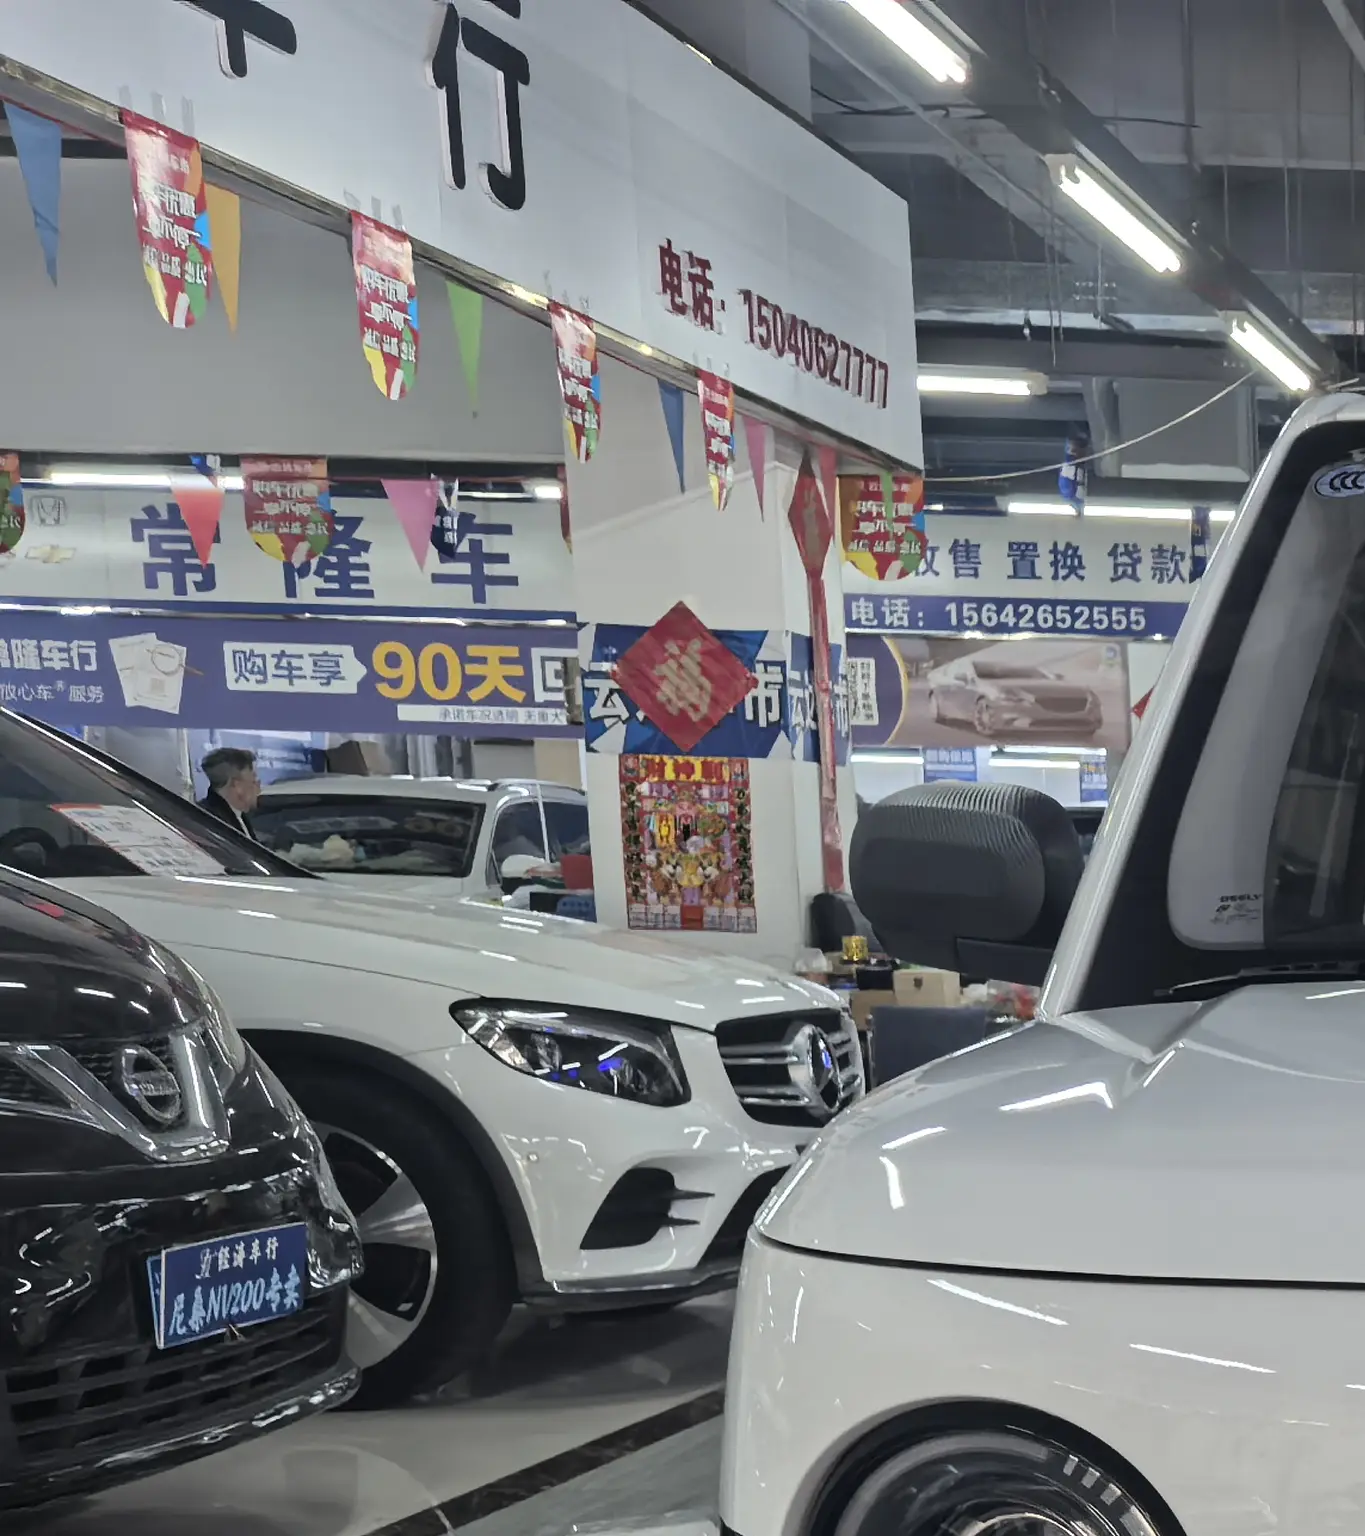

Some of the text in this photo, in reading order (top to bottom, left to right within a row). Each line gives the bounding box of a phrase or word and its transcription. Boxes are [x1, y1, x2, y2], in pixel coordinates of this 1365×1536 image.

[736, 288, 889, 410] 15040627777
[1007, 540, 1087, 582] 置换
[1107, 541, 1187, 585] 贷款
[944, 602, 1147, 633] 15642652555
[231, 647, 346, 687] 购车享
[371, 641, 527, 704] 90天
